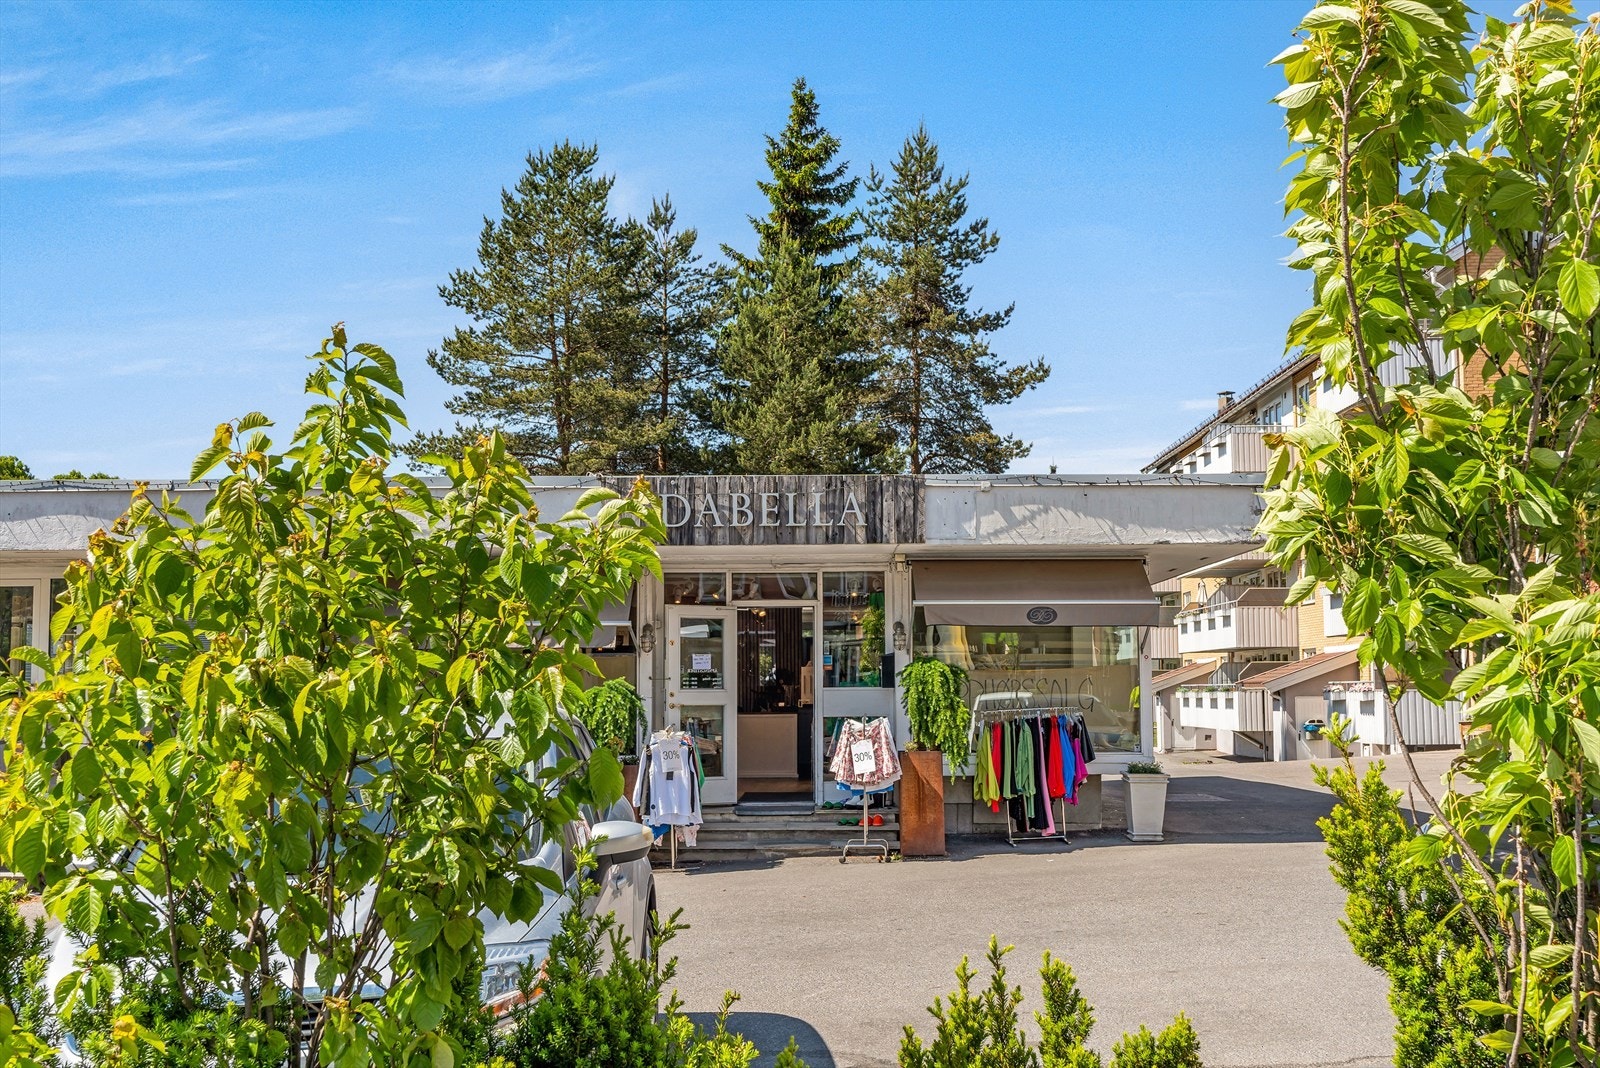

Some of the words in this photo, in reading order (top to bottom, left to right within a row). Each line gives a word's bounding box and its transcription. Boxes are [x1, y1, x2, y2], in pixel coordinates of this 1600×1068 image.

[659, 492, 868, 527] DABELLA
[662, 750, 680, 760] 30%
[854, 751, 873, 762] 30%
